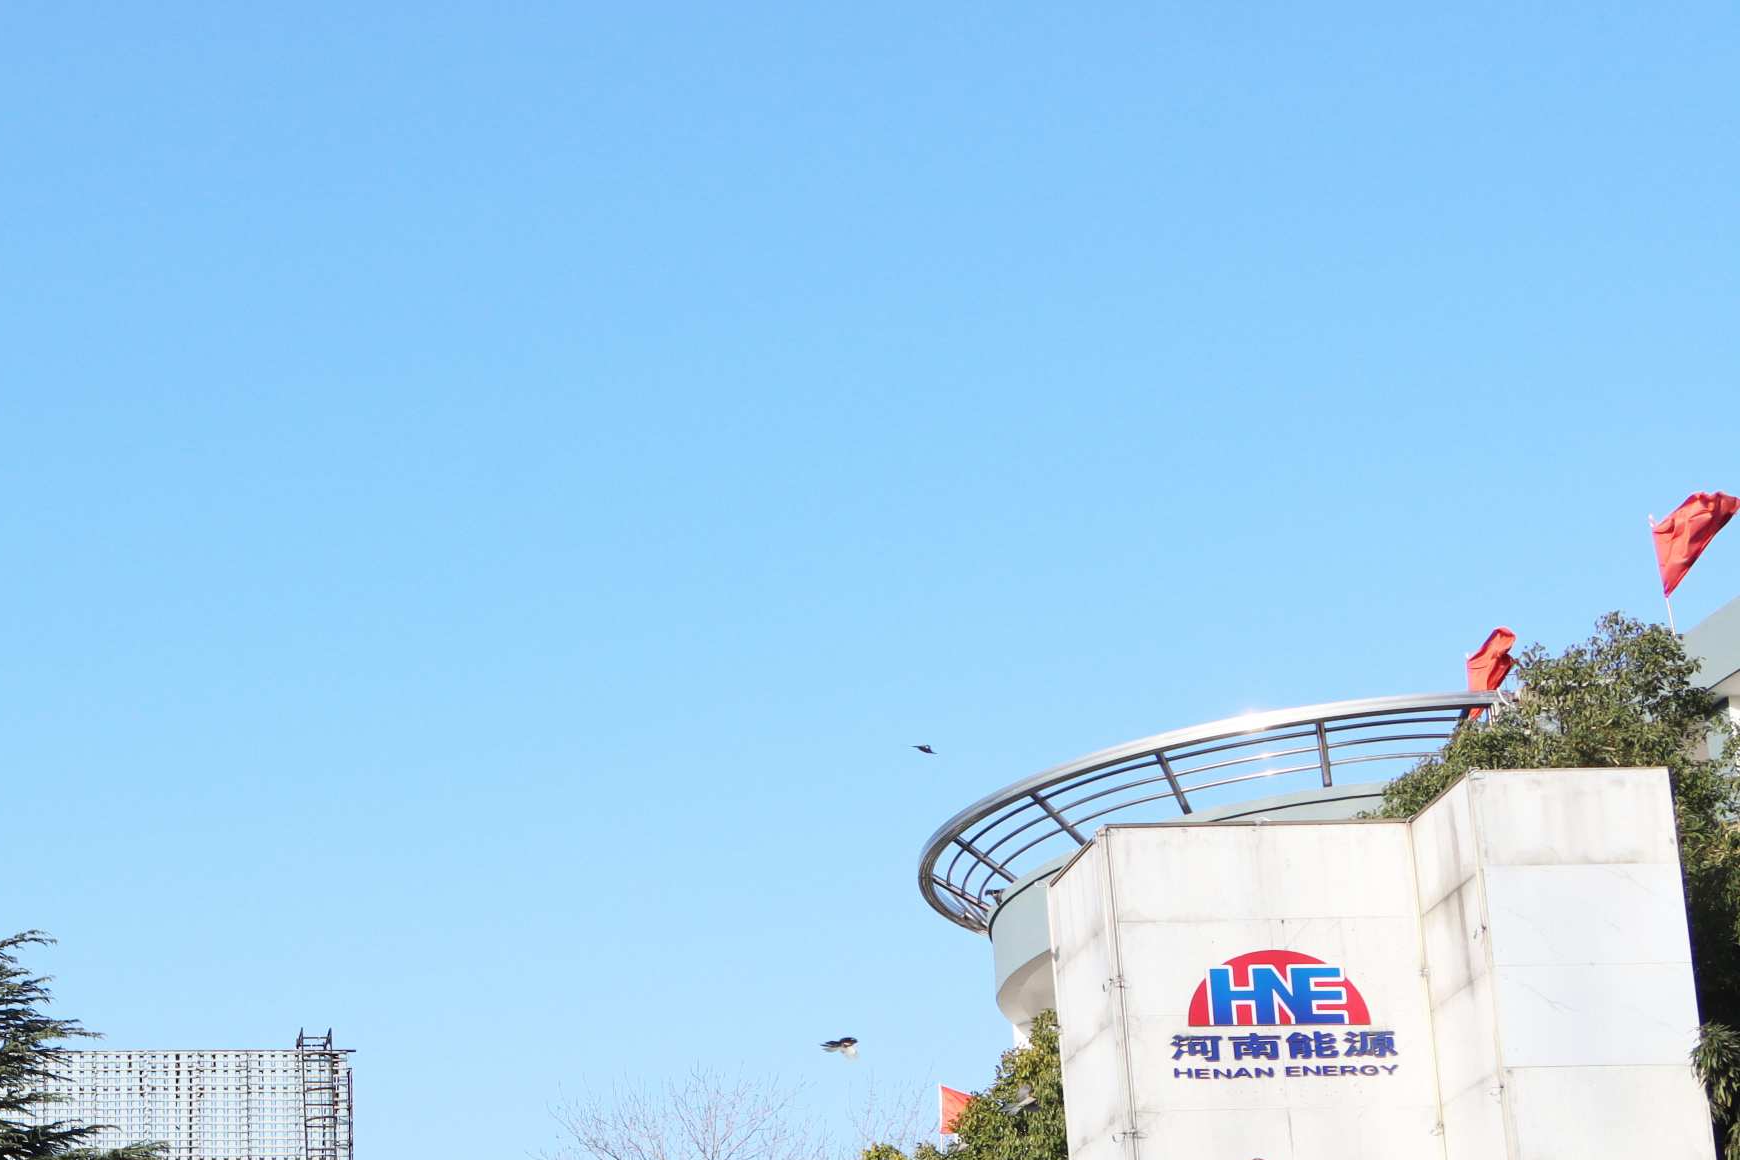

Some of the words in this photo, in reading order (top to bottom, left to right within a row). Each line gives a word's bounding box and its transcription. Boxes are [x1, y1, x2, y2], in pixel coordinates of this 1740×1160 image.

[1208, 966, 1348, 1025] HNE
[1171, 1031, 1398, 1062] 河南能源
[1173, 1066, 1274, 1080] HENAN
[1285, 1064, 1398, 1078] ENERGY
